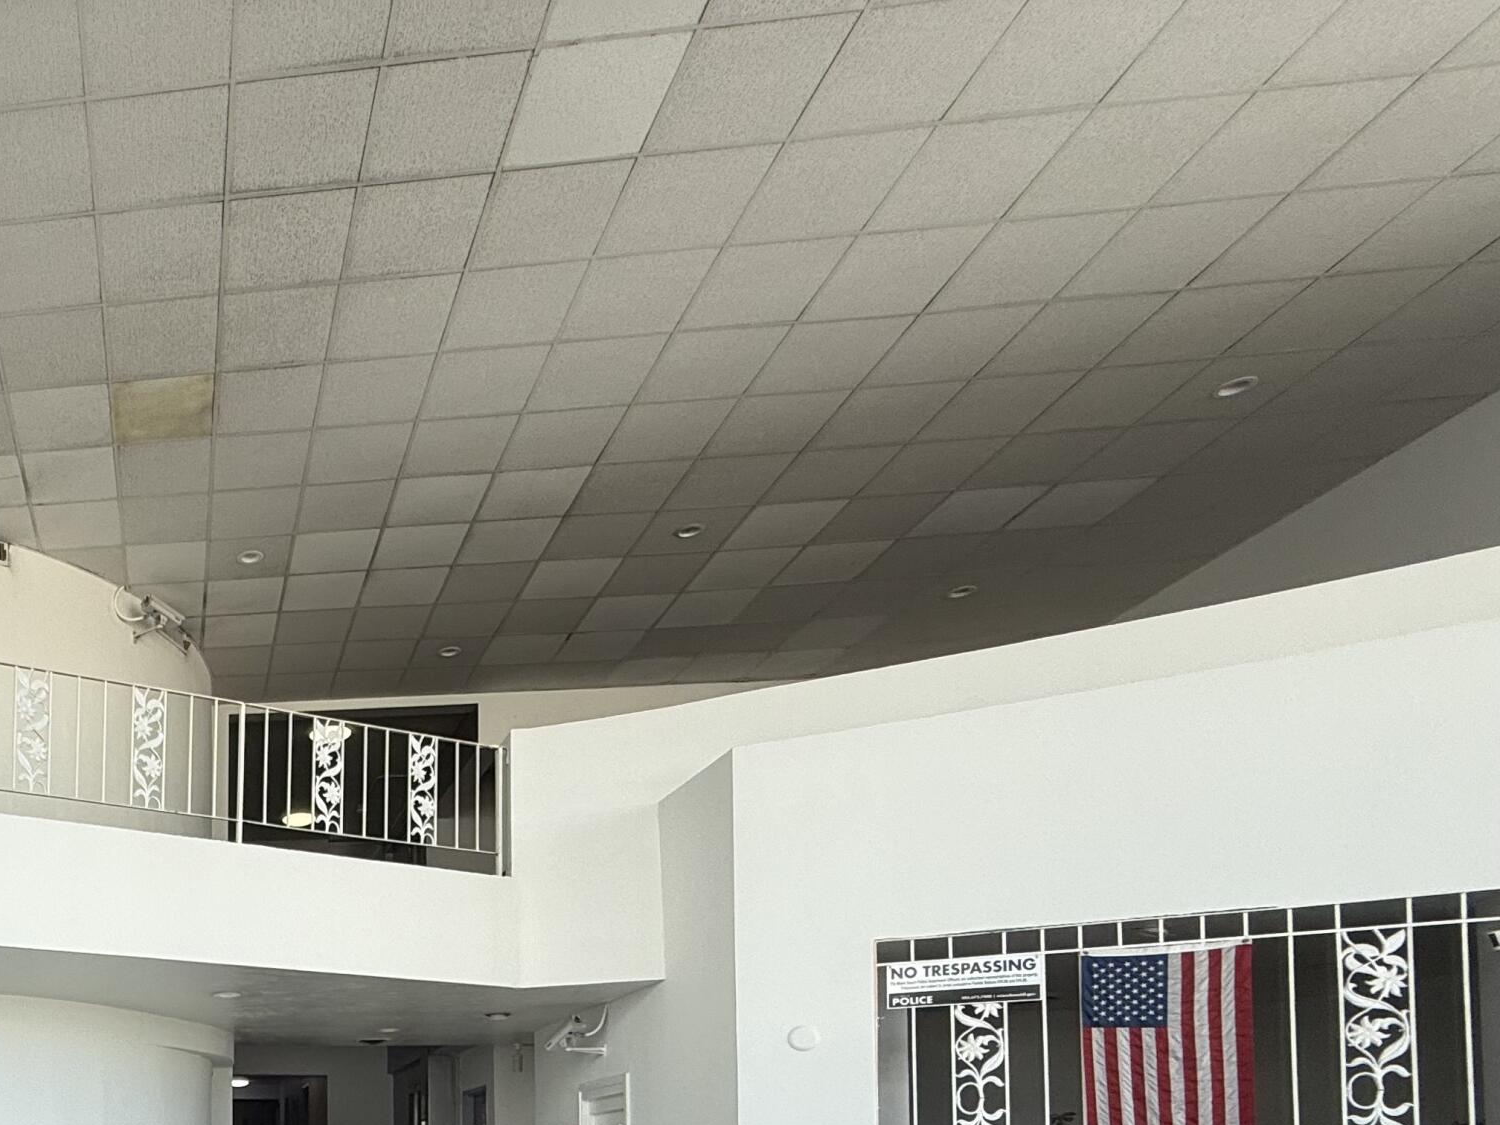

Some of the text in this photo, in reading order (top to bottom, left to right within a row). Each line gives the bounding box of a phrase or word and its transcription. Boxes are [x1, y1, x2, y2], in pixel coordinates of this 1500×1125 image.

[891, 966, 917, 980] NO
[923, 958, 1036, 977] TRESPASSING
[892, 995, 934, 1006] POLICE
